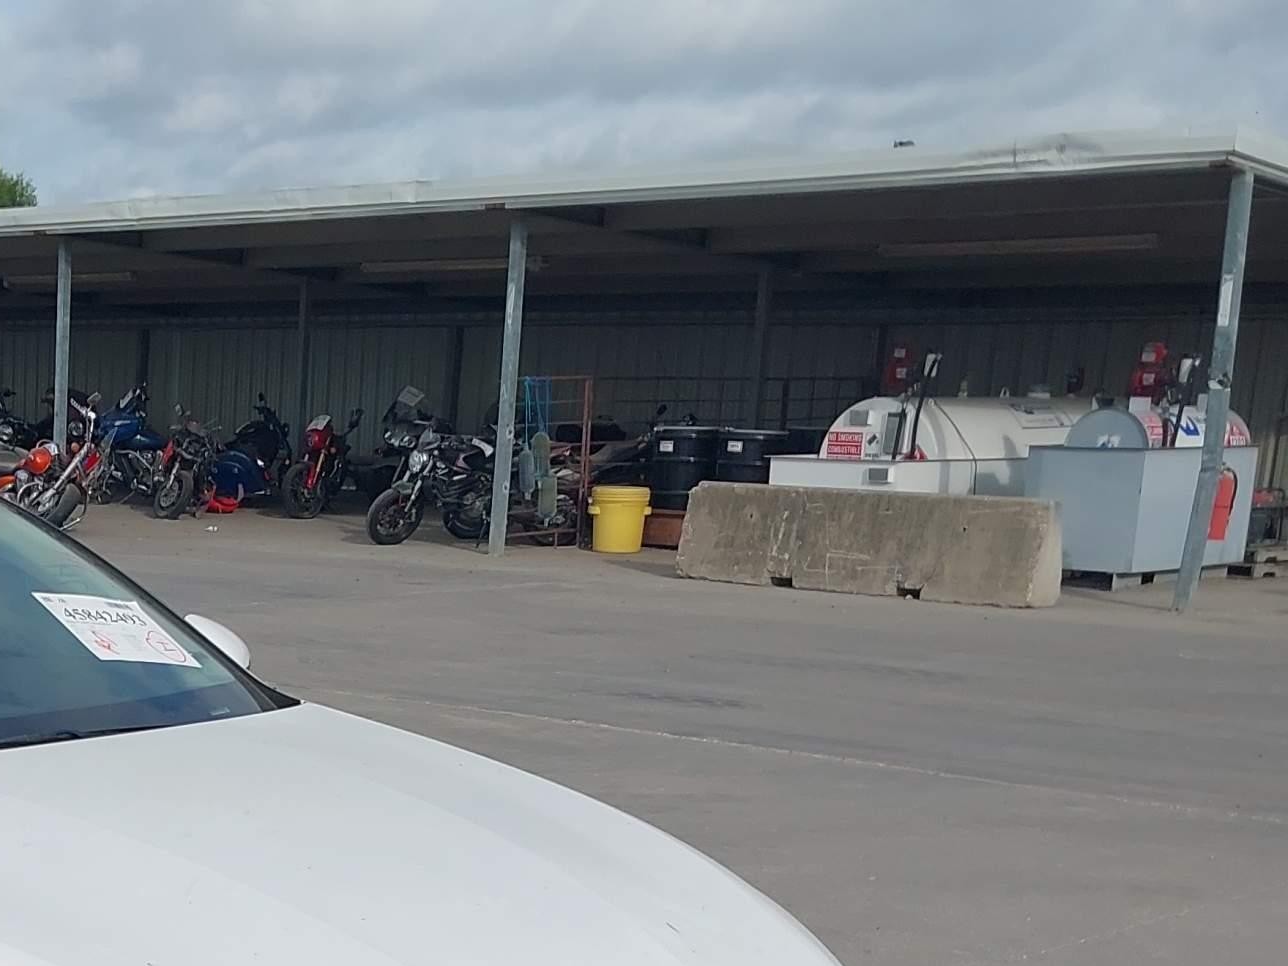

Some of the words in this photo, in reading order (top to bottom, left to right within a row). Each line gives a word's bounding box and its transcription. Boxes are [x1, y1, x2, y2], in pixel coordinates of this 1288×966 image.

[828, 432, 837, 442] NO
[838, 432, 863, 443] SMOKING
[63, 606, 148, 628] 45842493
